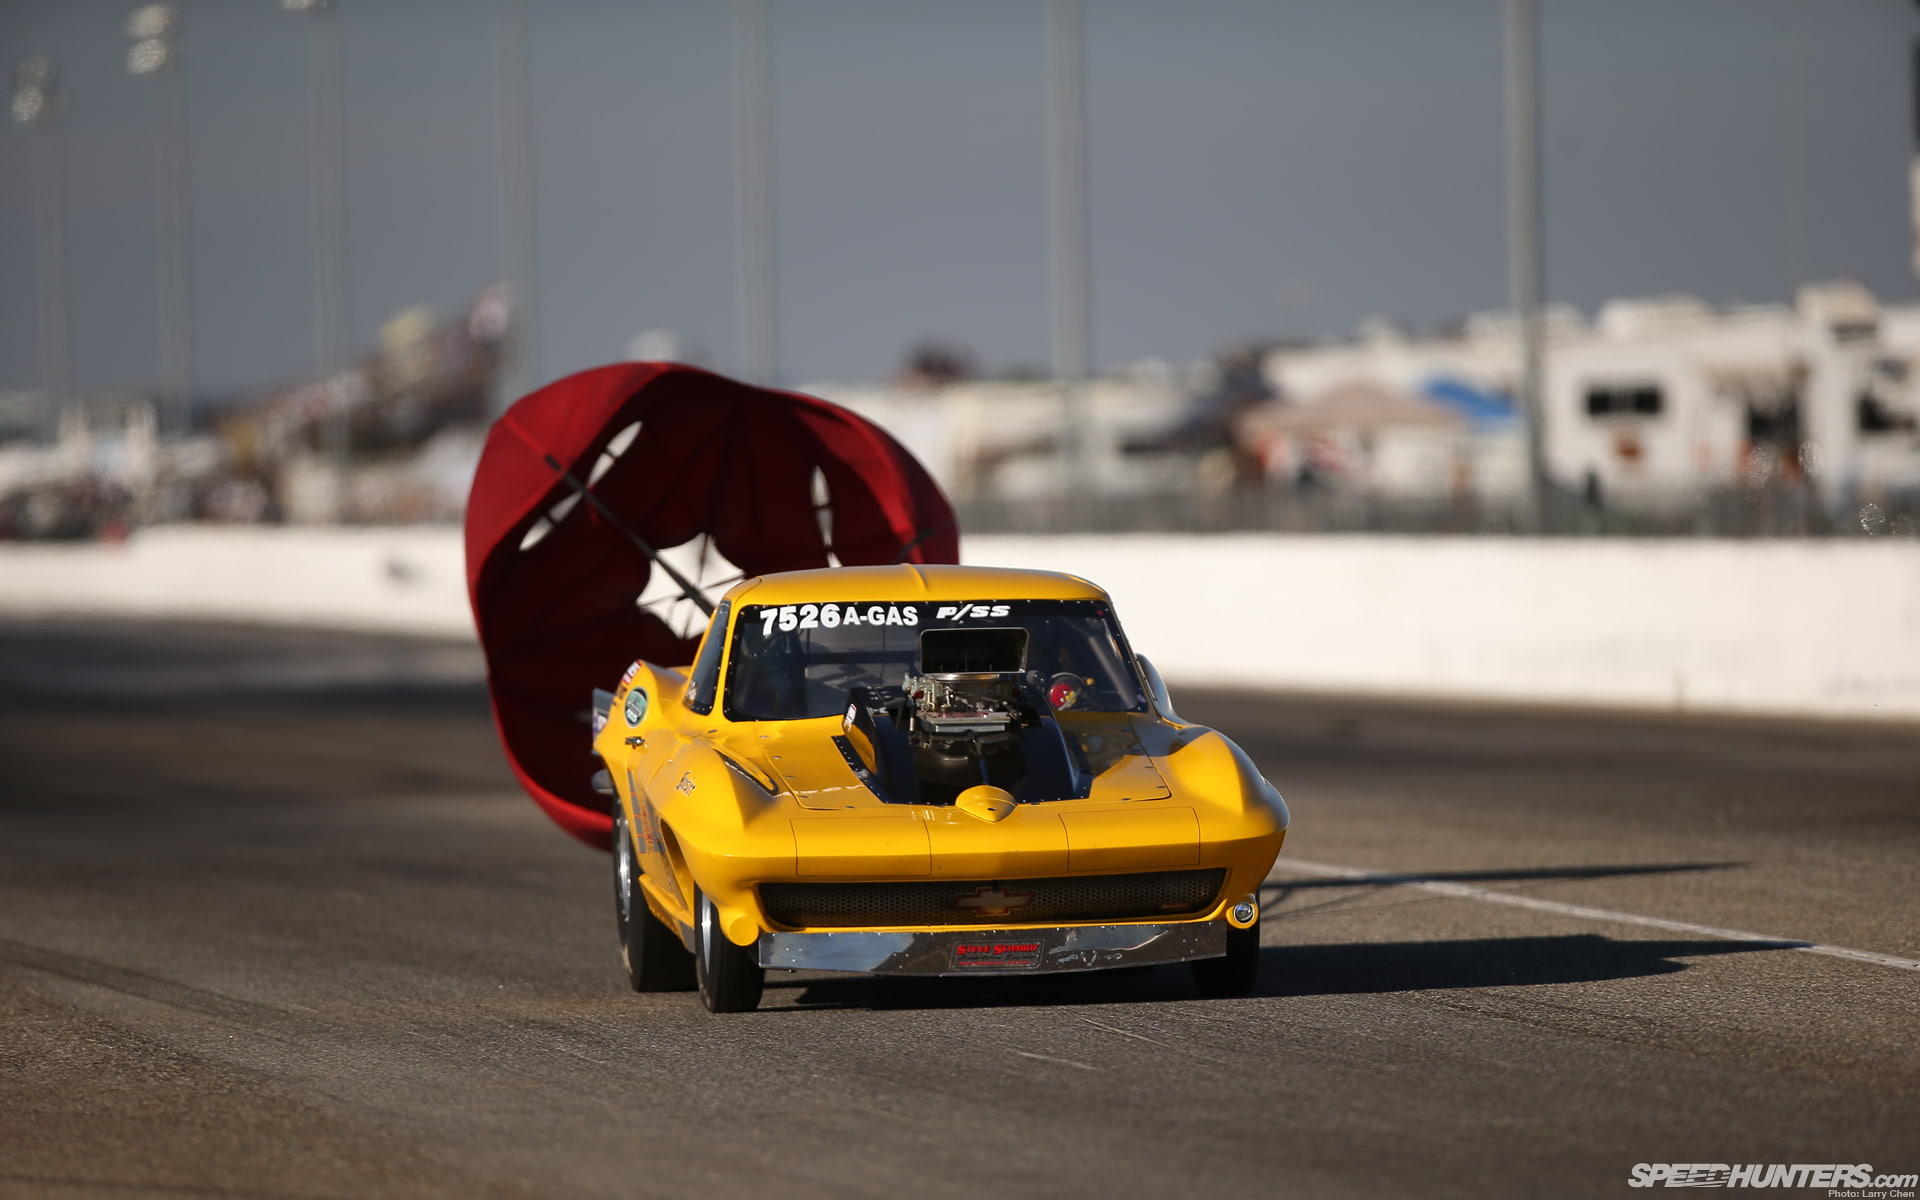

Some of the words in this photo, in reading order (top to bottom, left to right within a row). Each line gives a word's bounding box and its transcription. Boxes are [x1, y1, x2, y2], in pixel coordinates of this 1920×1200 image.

[760, 603, 840, 636] 7526
[843, 606, 919, 626] A-GAS
[936, 604, 1011, 620] P/SS
